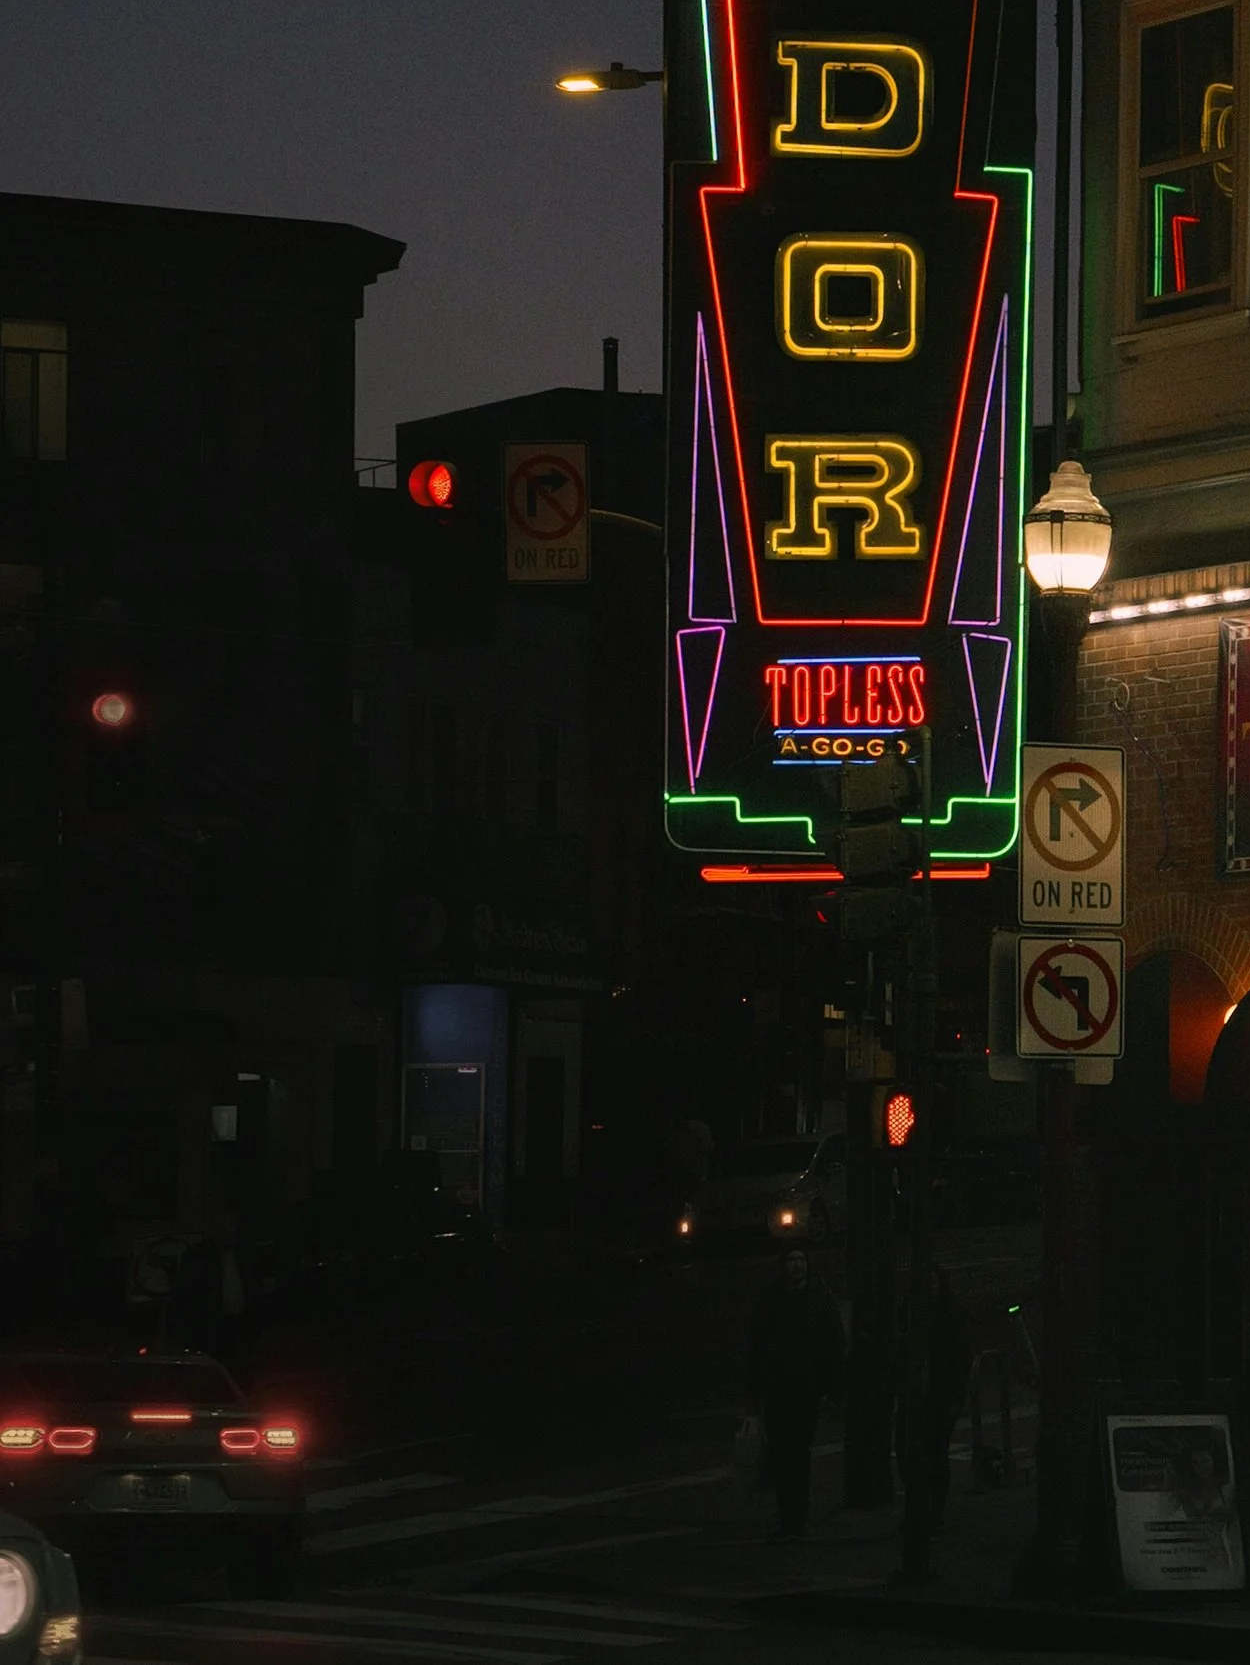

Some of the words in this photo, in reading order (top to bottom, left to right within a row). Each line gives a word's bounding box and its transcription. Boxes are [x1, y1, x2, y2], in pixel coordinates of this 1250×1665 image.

[514, 548, 537, 569] ON
[546, 548, 579, 569] RED
[764, 663, 926, 727] TOPLESS
[1033, 880, 1061, 908] ON
[1071, 881, 1112, 909] RED
